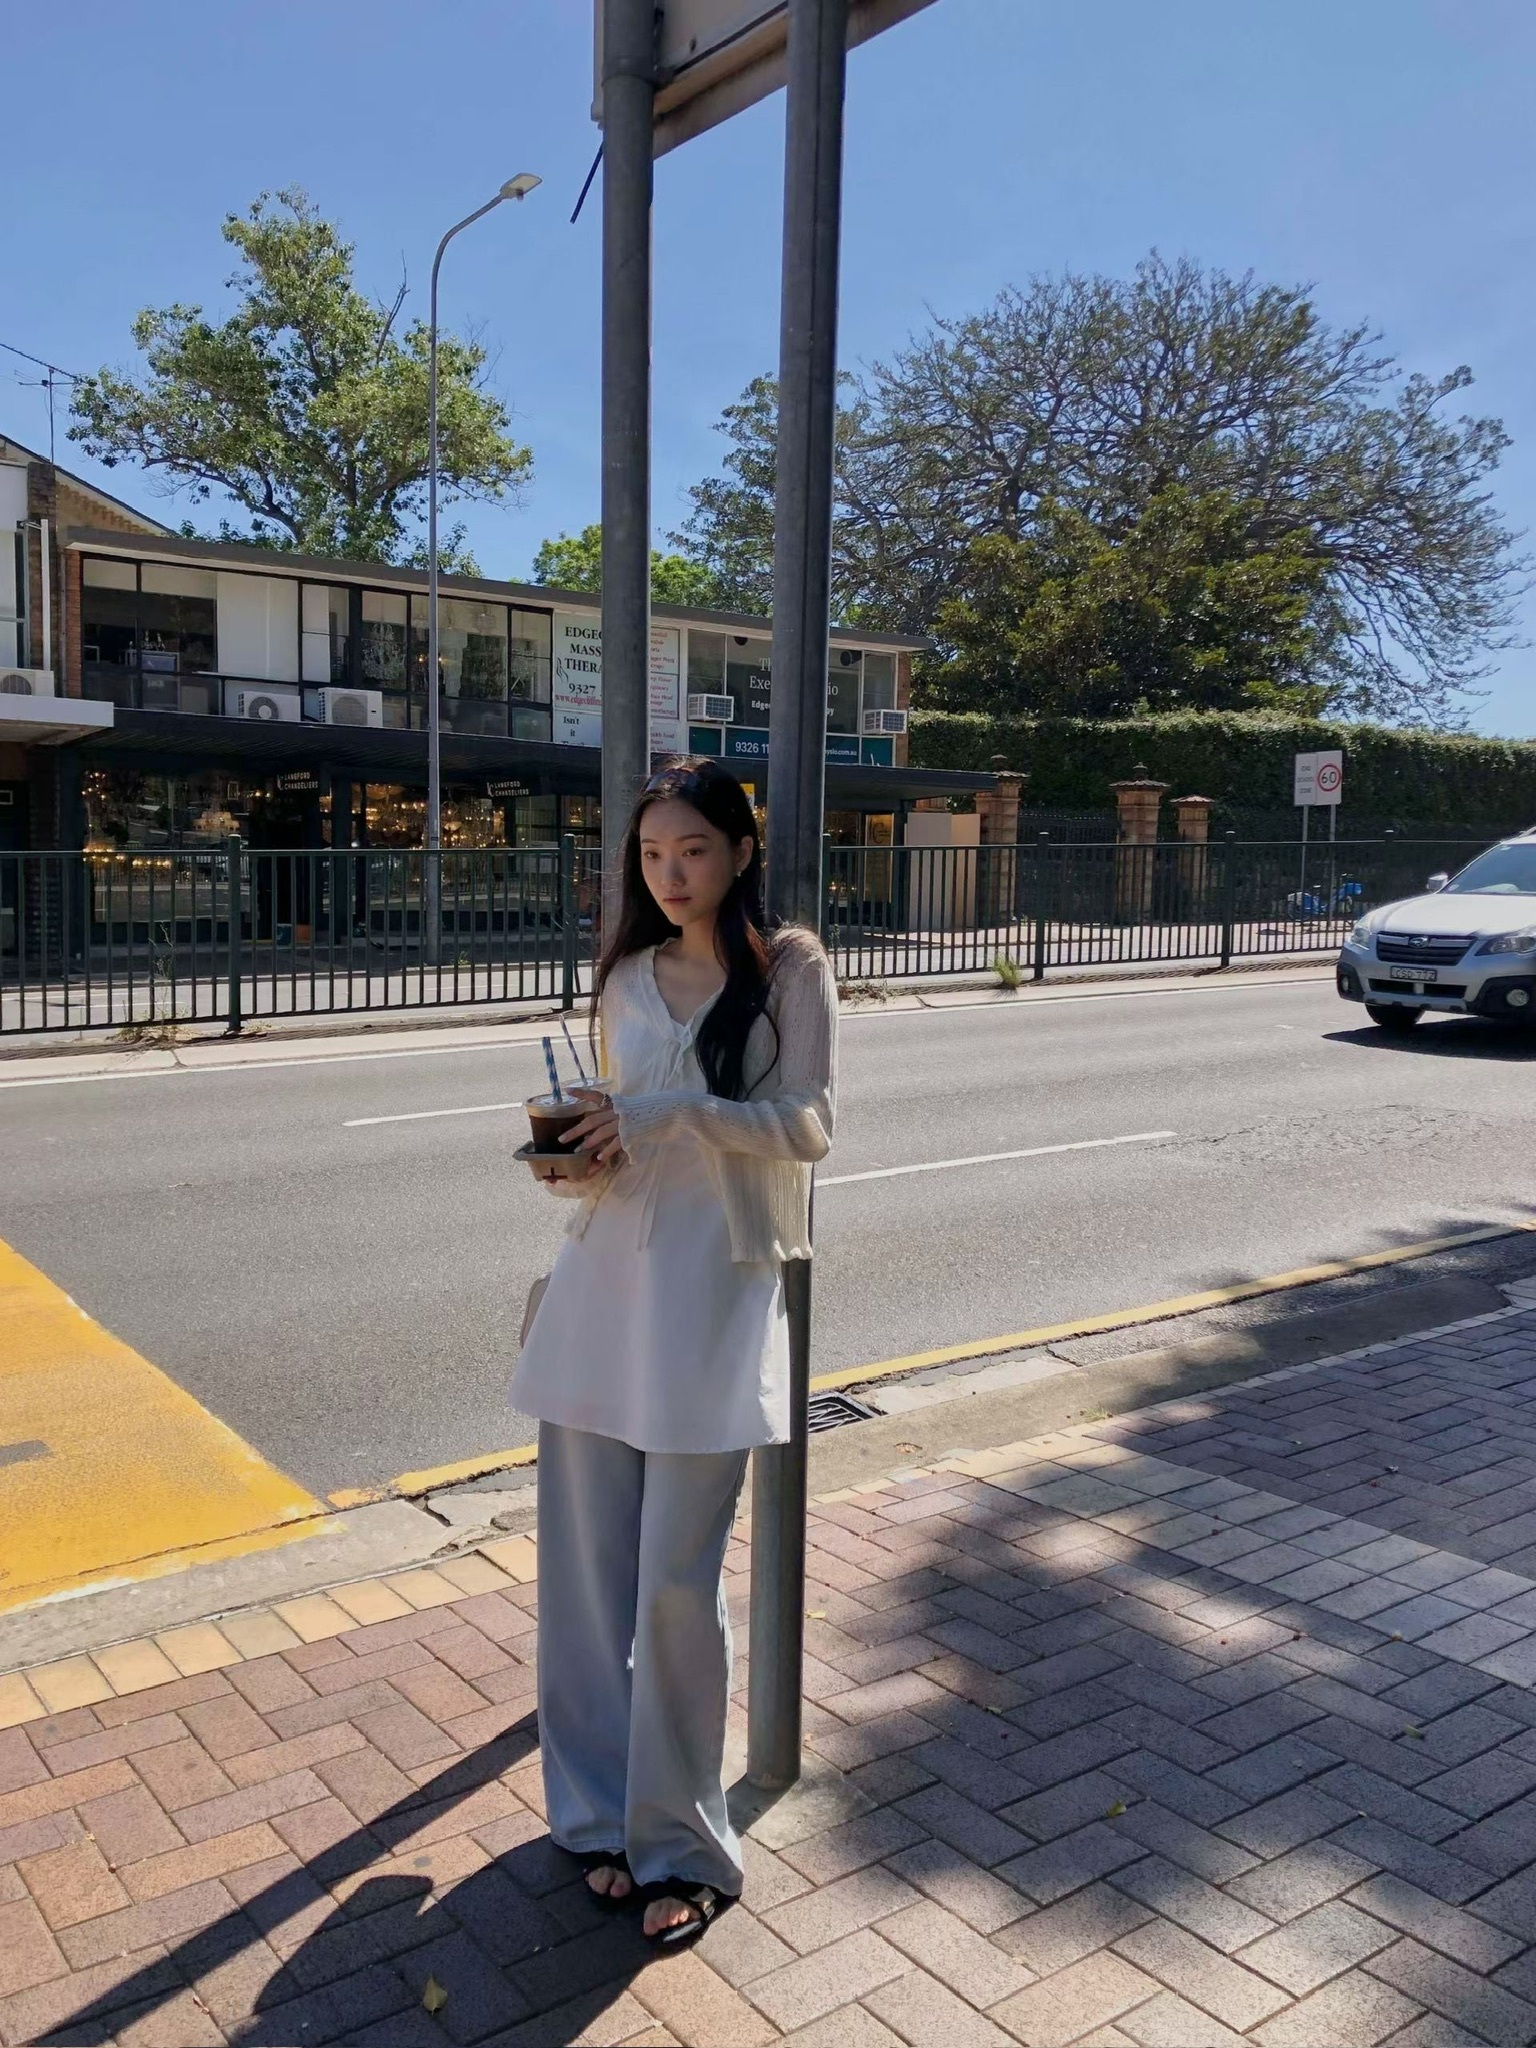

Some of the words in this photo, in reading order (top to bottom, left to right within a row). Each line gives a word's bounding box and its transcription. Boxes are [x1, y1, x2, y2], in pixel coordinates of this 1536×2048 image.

[569, 683, 596, 695] 9327
[563, 716, 580, 725] Isn't
[570, 729, 576, 737] it
[735, 741, 759, 754] 9326
[1321, 771, 1337, 784] 60
